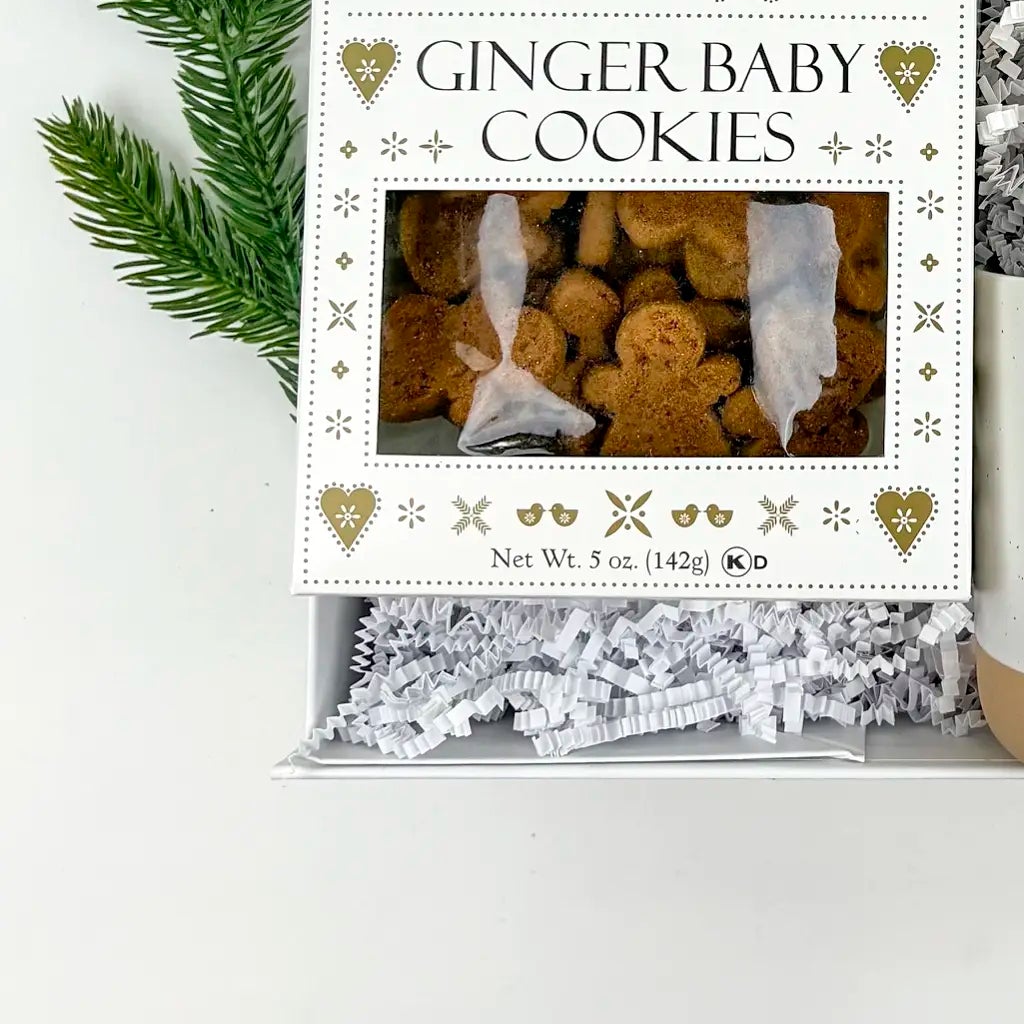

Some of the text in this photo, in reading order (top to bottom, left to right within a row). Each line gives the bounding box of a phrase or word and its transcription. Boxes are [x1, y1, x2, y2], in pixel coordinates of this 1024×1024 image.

[416, 39, 866, 94] GINGER BABY
[481, 109, 795, 163] COOKIES
[490, 547, 534, 569] Net
[540, 548, 582, 569] Wt.
[589, 549, 602, 569] 5
[608, 555, 638, 571] oz.
[645, 549, 710, 577] (142g)
